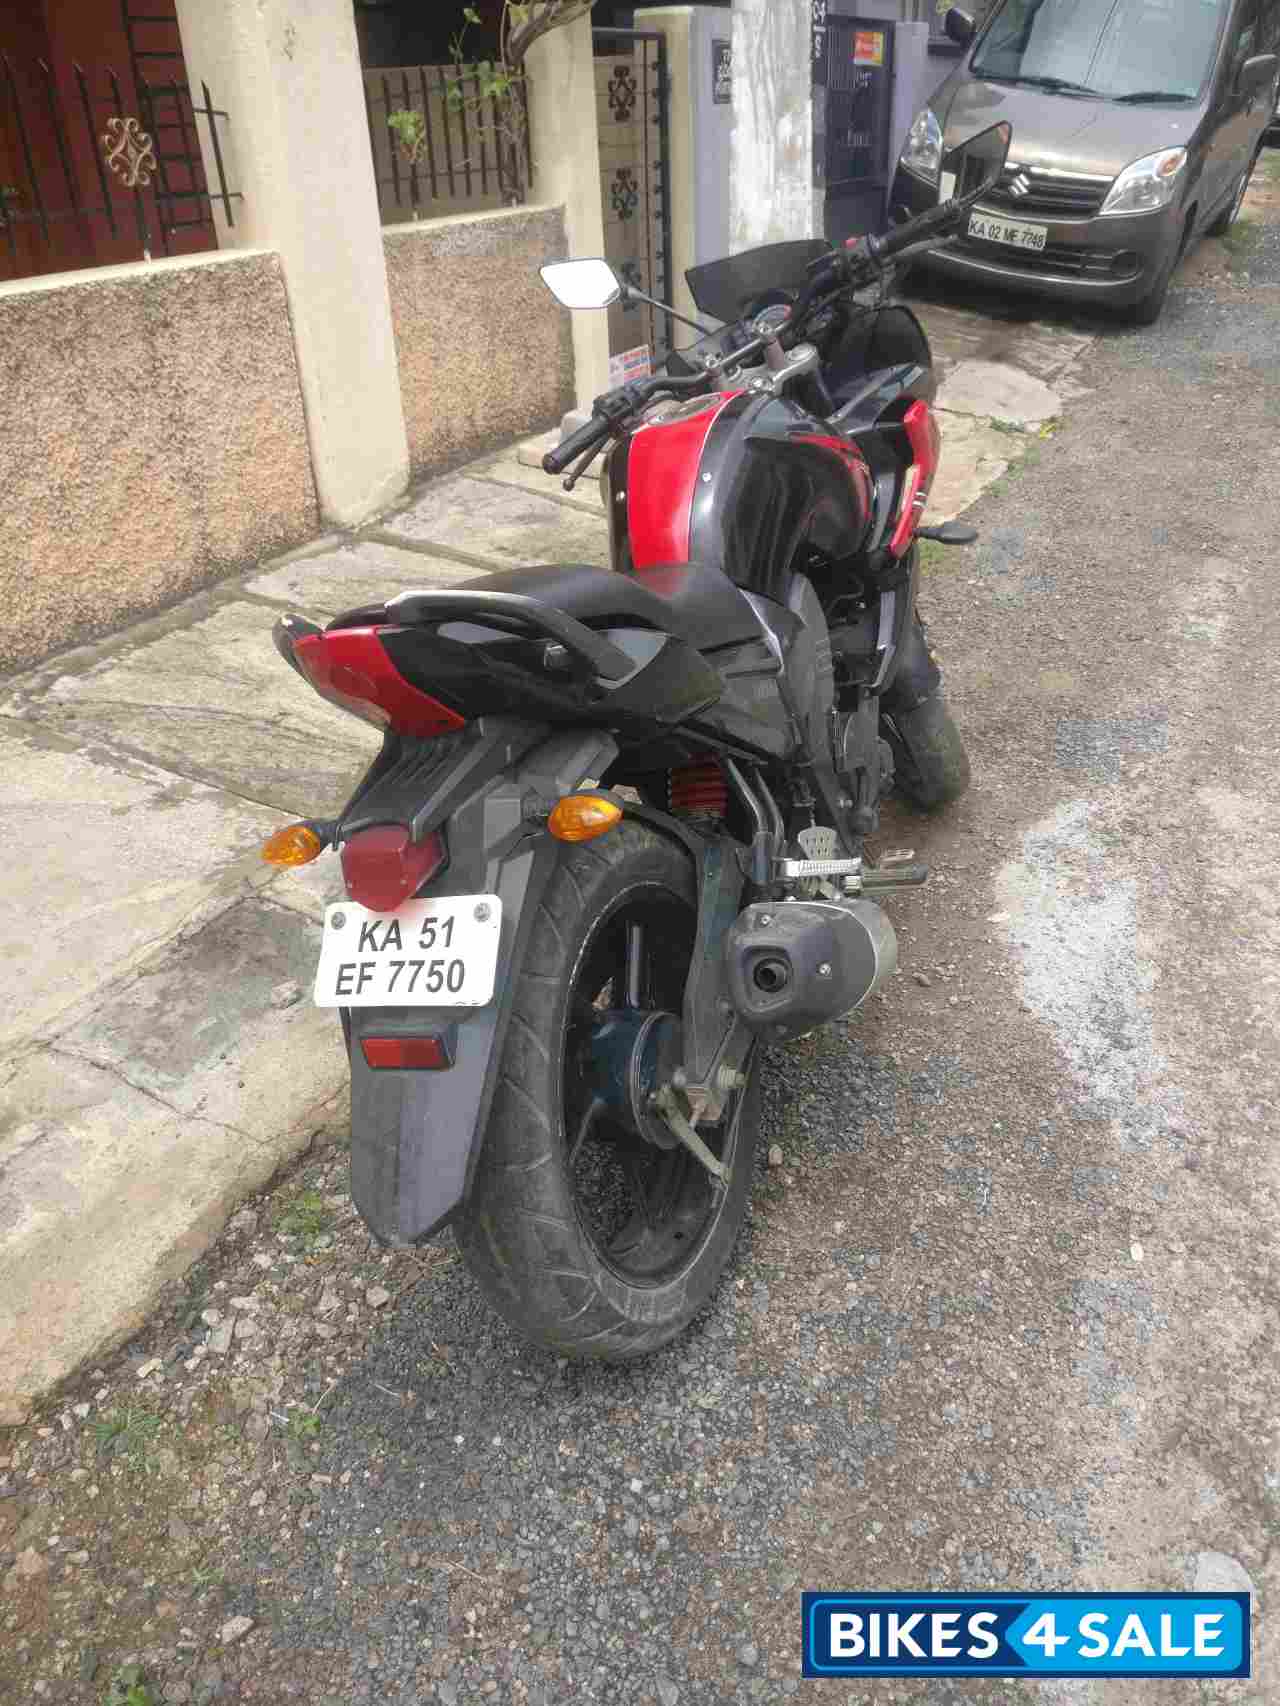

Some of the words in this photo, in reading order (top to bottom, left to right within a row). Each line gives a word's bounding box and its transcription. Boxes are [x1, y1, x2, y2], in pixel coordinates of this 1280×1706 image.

[970, 220, 985, 236] KA
[990, 224, 1001, 240] 02
[358, 919, 403, 952] KA
[418, 915, 455, 950] 51
[335, 961, 377, 996] EF
[387, 958, 465, 994] 7750
